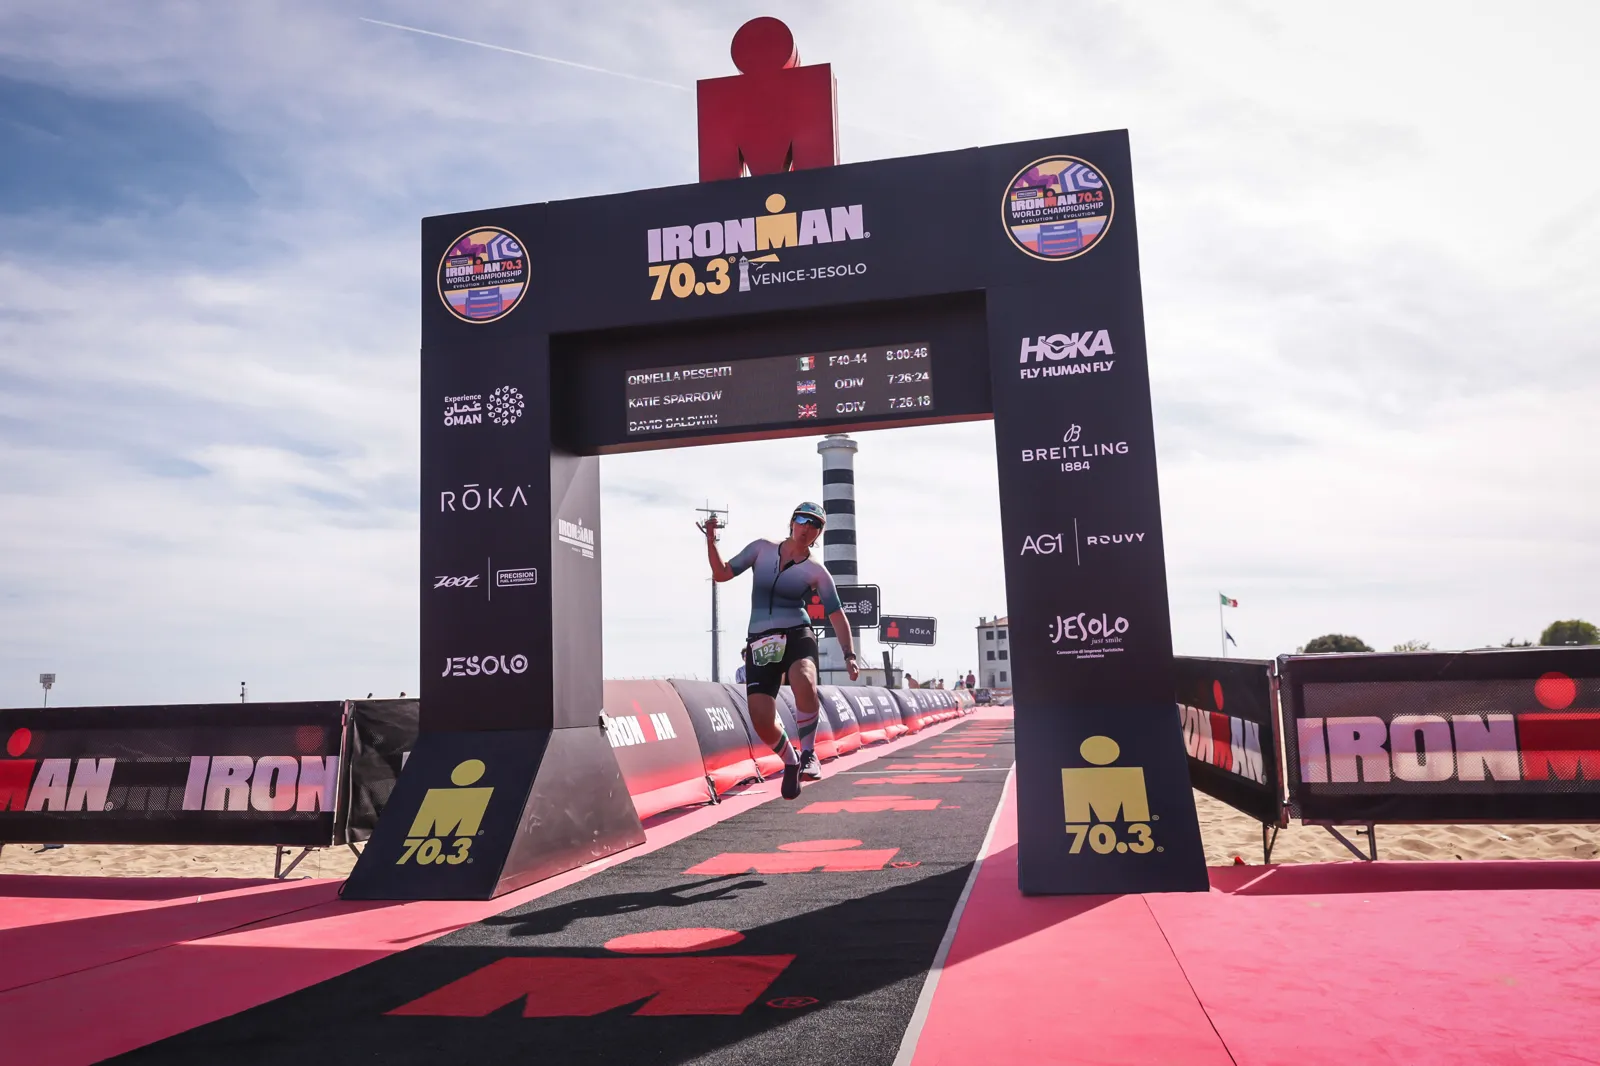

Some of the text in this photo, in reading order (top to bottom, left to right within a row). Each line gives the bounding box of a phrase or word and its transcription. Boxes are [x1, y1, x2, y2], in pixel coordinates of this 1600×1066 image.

[1011, 191, 1077, 211] IRONMAN
[1078, 191, 1103, 203] 70.3
[1012, 202, 1104, 218] WORLD CHAMPIONSHIP
[648, 193, 864, 263] IRONMAN
[446, 259, 500, 277] IRONMAN
[501, 259, 522, 271] 70.3
[446, 270, 522, 284] WORLD CHAMPIONSHIP
[648, 257, 867, 300] 70.3 VENICE-JESOLO
[1020, 329, 1113, 363] HOKA
[829, 353, 867, 366] F40-44
[628, 366, 732, 385] ORNELLA PESENTI
[1020, 361, 1114, 379] FLY HUMAN FLY
[444, 394, 482, 403] Experience
[628, 390, 723, 408] KATIE SPARROW
[444, 413, 482, 426] OMAN
[1022, 441, 1129, 462] BREITLING
[1061, 461, 1090, 472] 1884
[1020, 533, 1063, 555] AG1
[1087, 533, 1145, 545] ROUVY
[500, 571, 534, 579] PRECISION
[442, 654, 528, 677] JESOLO
[182, 755, 340, 812] IRON
[1065, 823, 1154, 854] 70.3
[395, 837, 472, 865] 70.3
